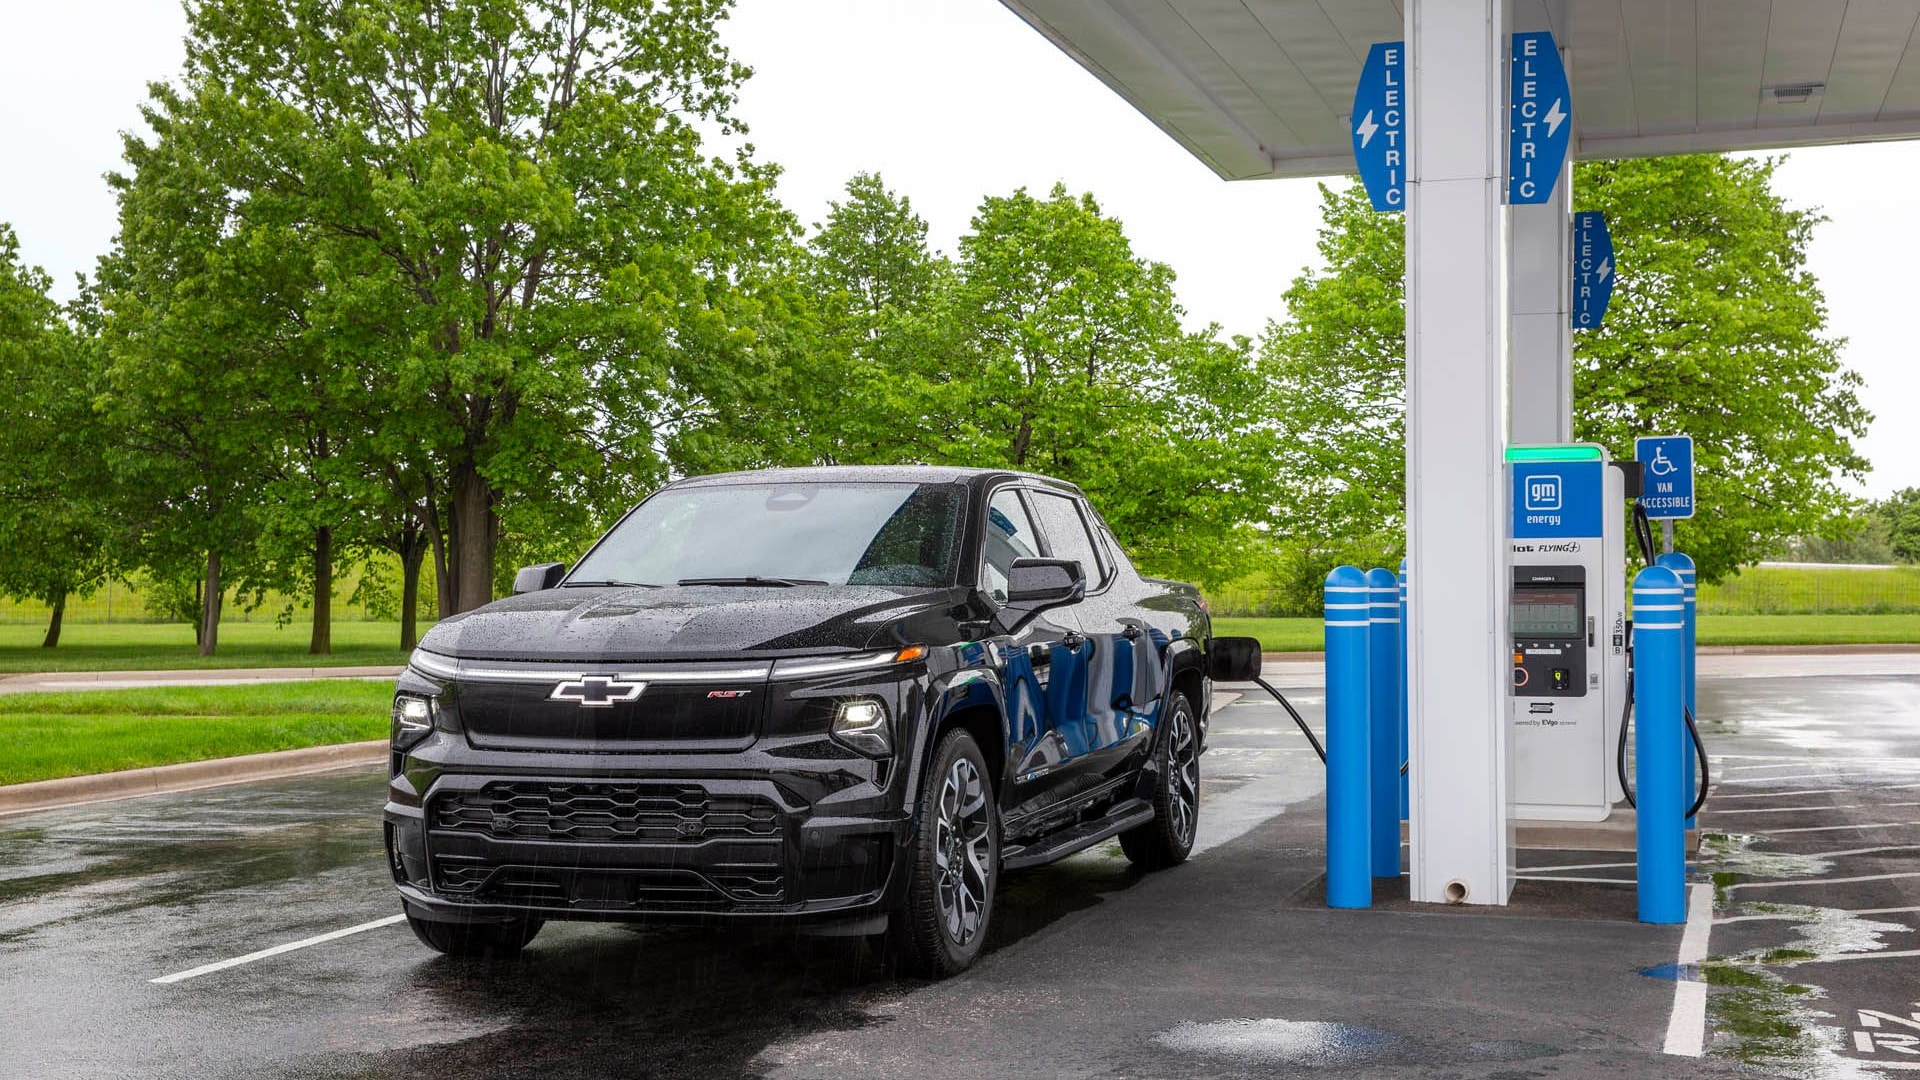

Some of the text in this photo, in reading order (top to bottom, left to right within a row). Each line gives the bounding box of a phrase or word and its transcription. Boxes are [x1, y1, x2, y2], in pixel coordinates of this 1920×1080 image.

[1519, 39, 1537, 198] ELECTRIC
[1384, 49, 1401, 205] ELECTRIC
[1579, 216, 1592, 325] ELECTRIC
[1531, 483, 1556, 501] gm
[1656, 482, 1673, 493] VAN
[1641, 496, 1690, 509] ACCESSIBLE
[1526, 515, 1561, 526] energy
[707, 690, 752, 699] RST
[1541, 719, 1559, 727] EVgo
